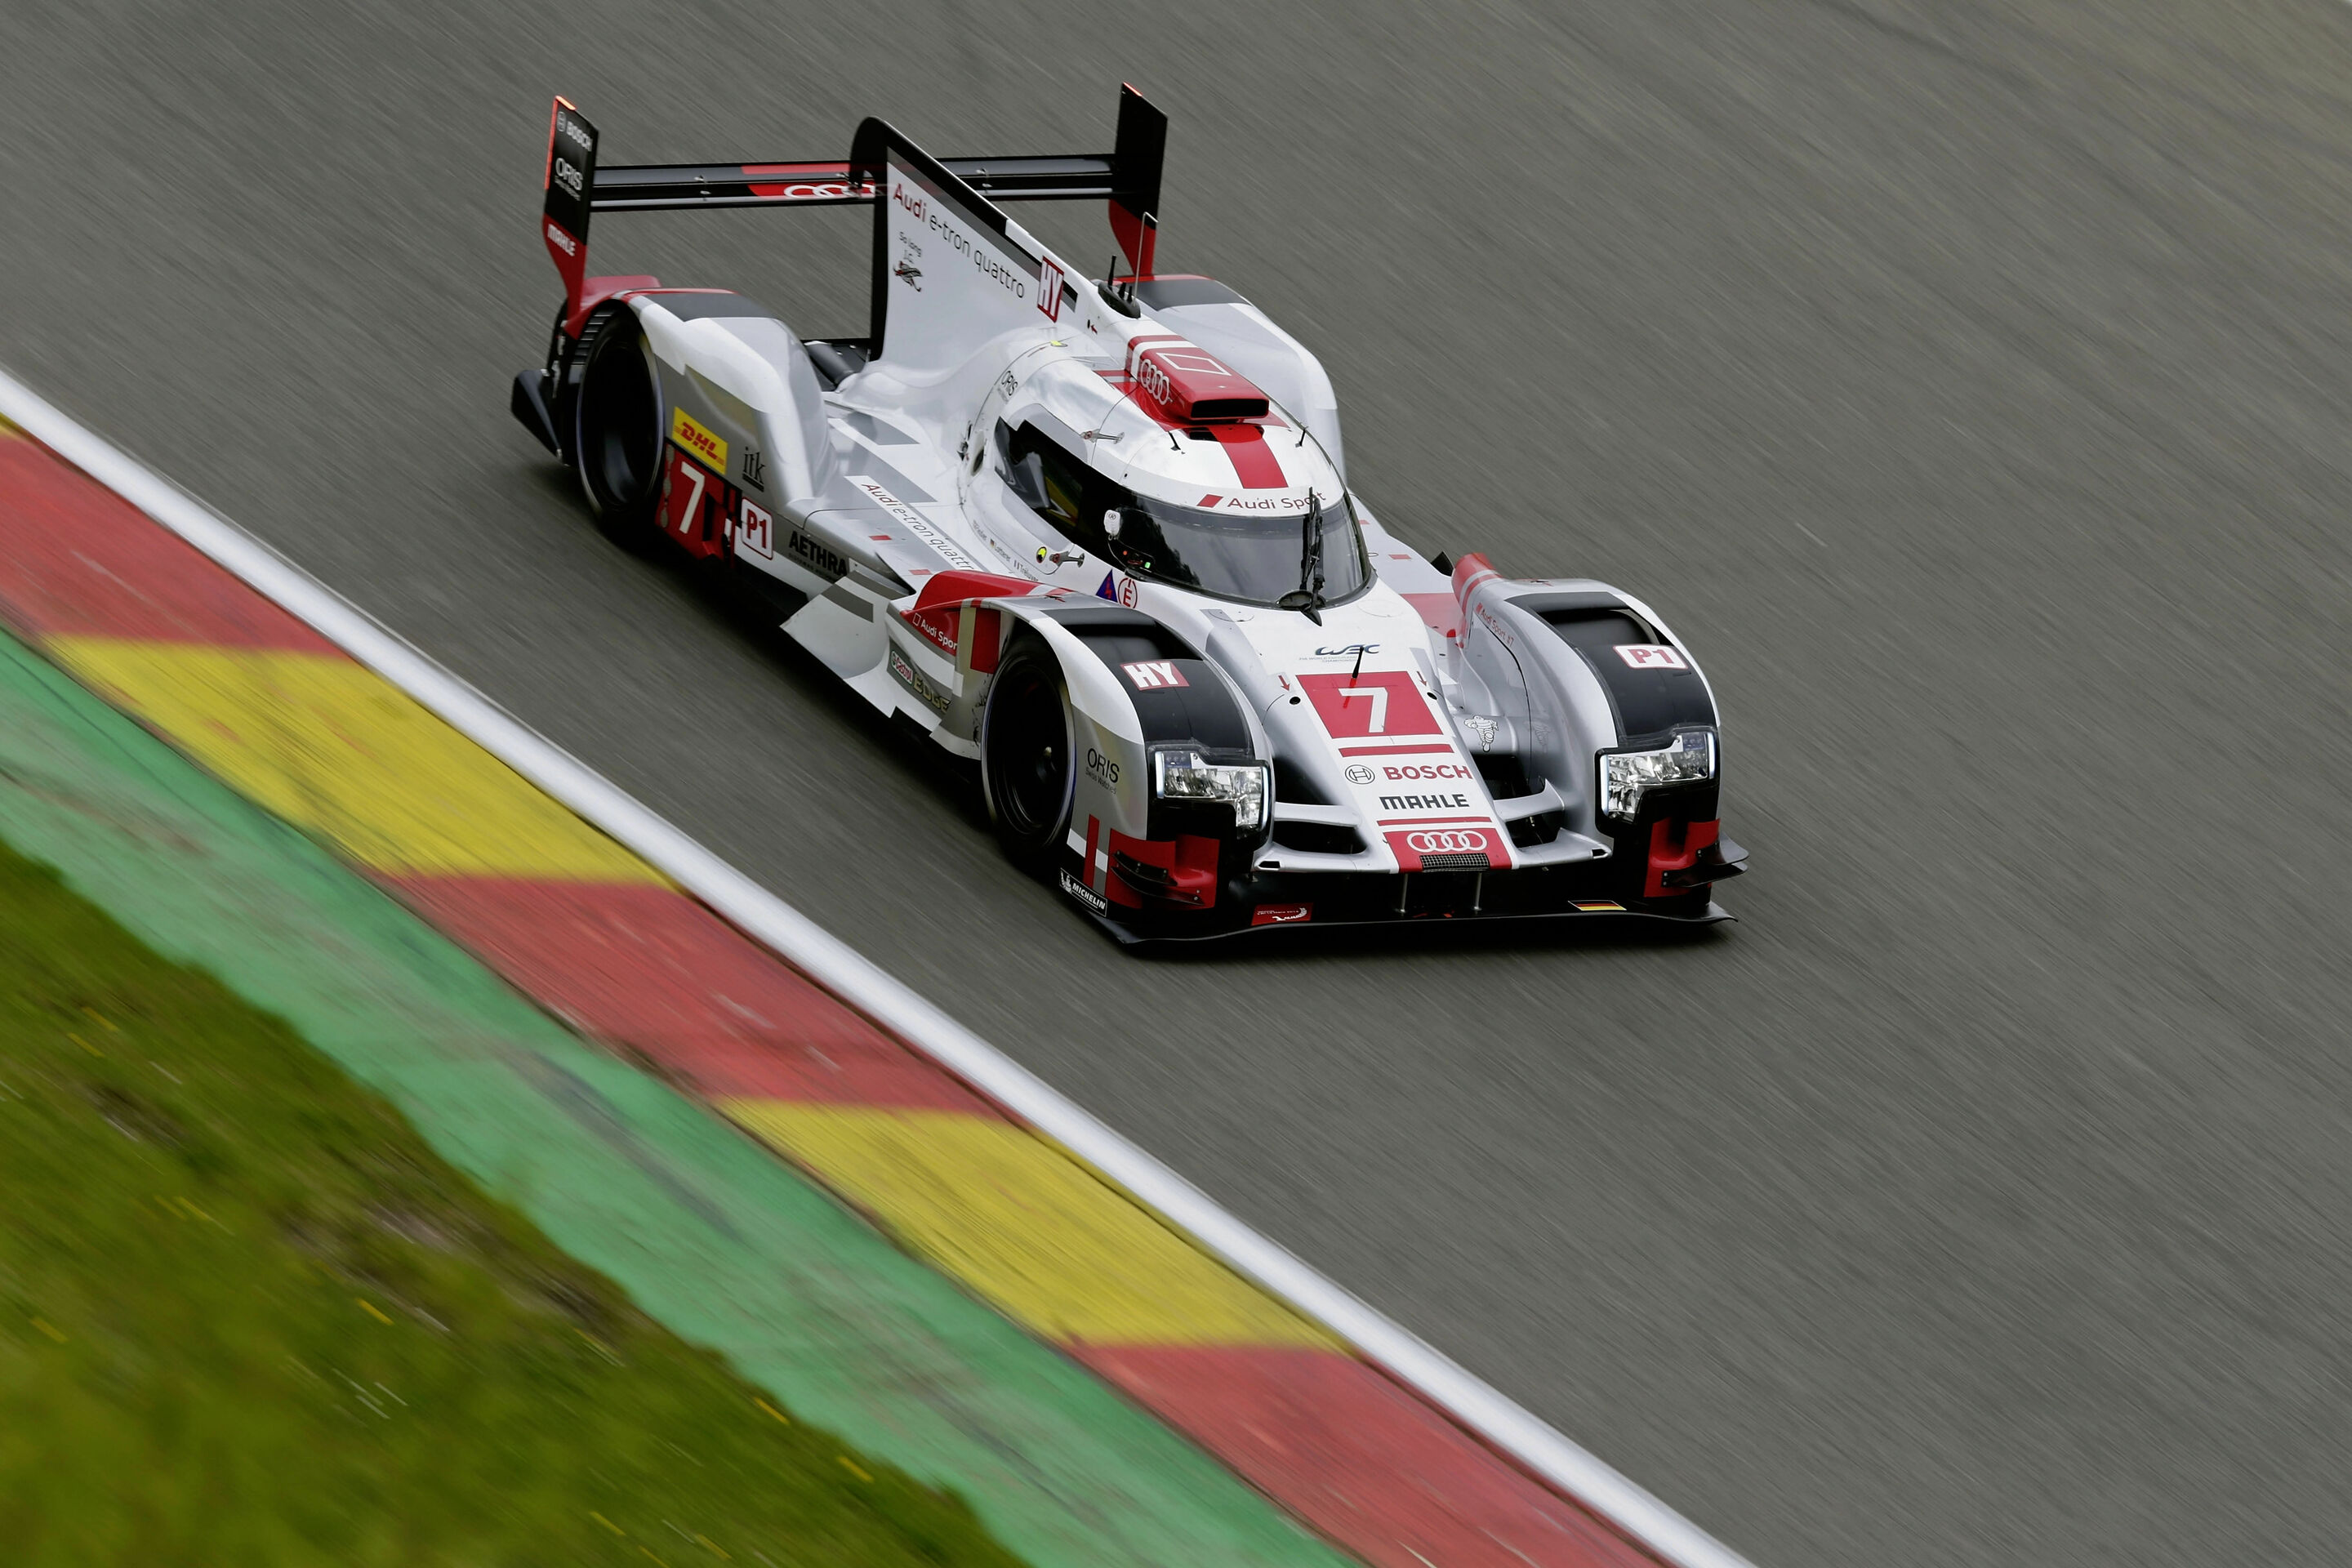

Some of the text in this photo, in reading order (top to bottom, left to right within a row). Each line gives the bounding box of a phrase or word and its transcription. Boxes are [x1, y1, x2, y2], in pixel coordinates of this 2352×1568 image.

[566, 121, 593, 152] BOSCH
[555, 158, 583, 190] ORIS
[547, 223, 577, 257] MAHLE
[893, 183, 1025, 298] Audi e-tron quattro
[1037, 260, 1064, 318] HY
[1001, 370, 1018, 396] ORIS
[680, 421, 718, 460] DHL
[679, 461, 706, 534] 7
[1227, 492, 1327, 510] Audi Spot
[746, 508, 767, 550] P1
[861, 483, 975, 570] Audi e-tron quattr
[789, 531, 848, 577] AETHRA
[920, 619, 958, 649] Audi Spor
[893, 654, 912, 683] Castrol
[1627, 648, 1675, 665] P1
[1123, 662, 1179, 688] HY
[913, 673, 951, 713] EDGE
[1338, 687, 1388, 733] 7
[1087, 748, 1120, 783] ORIS
[1382, 764, 1473, 781] BOSCH
[1379, 794, 1470, 810] MAHLE
[1072, 882, 1106, 910] MICHELIN
